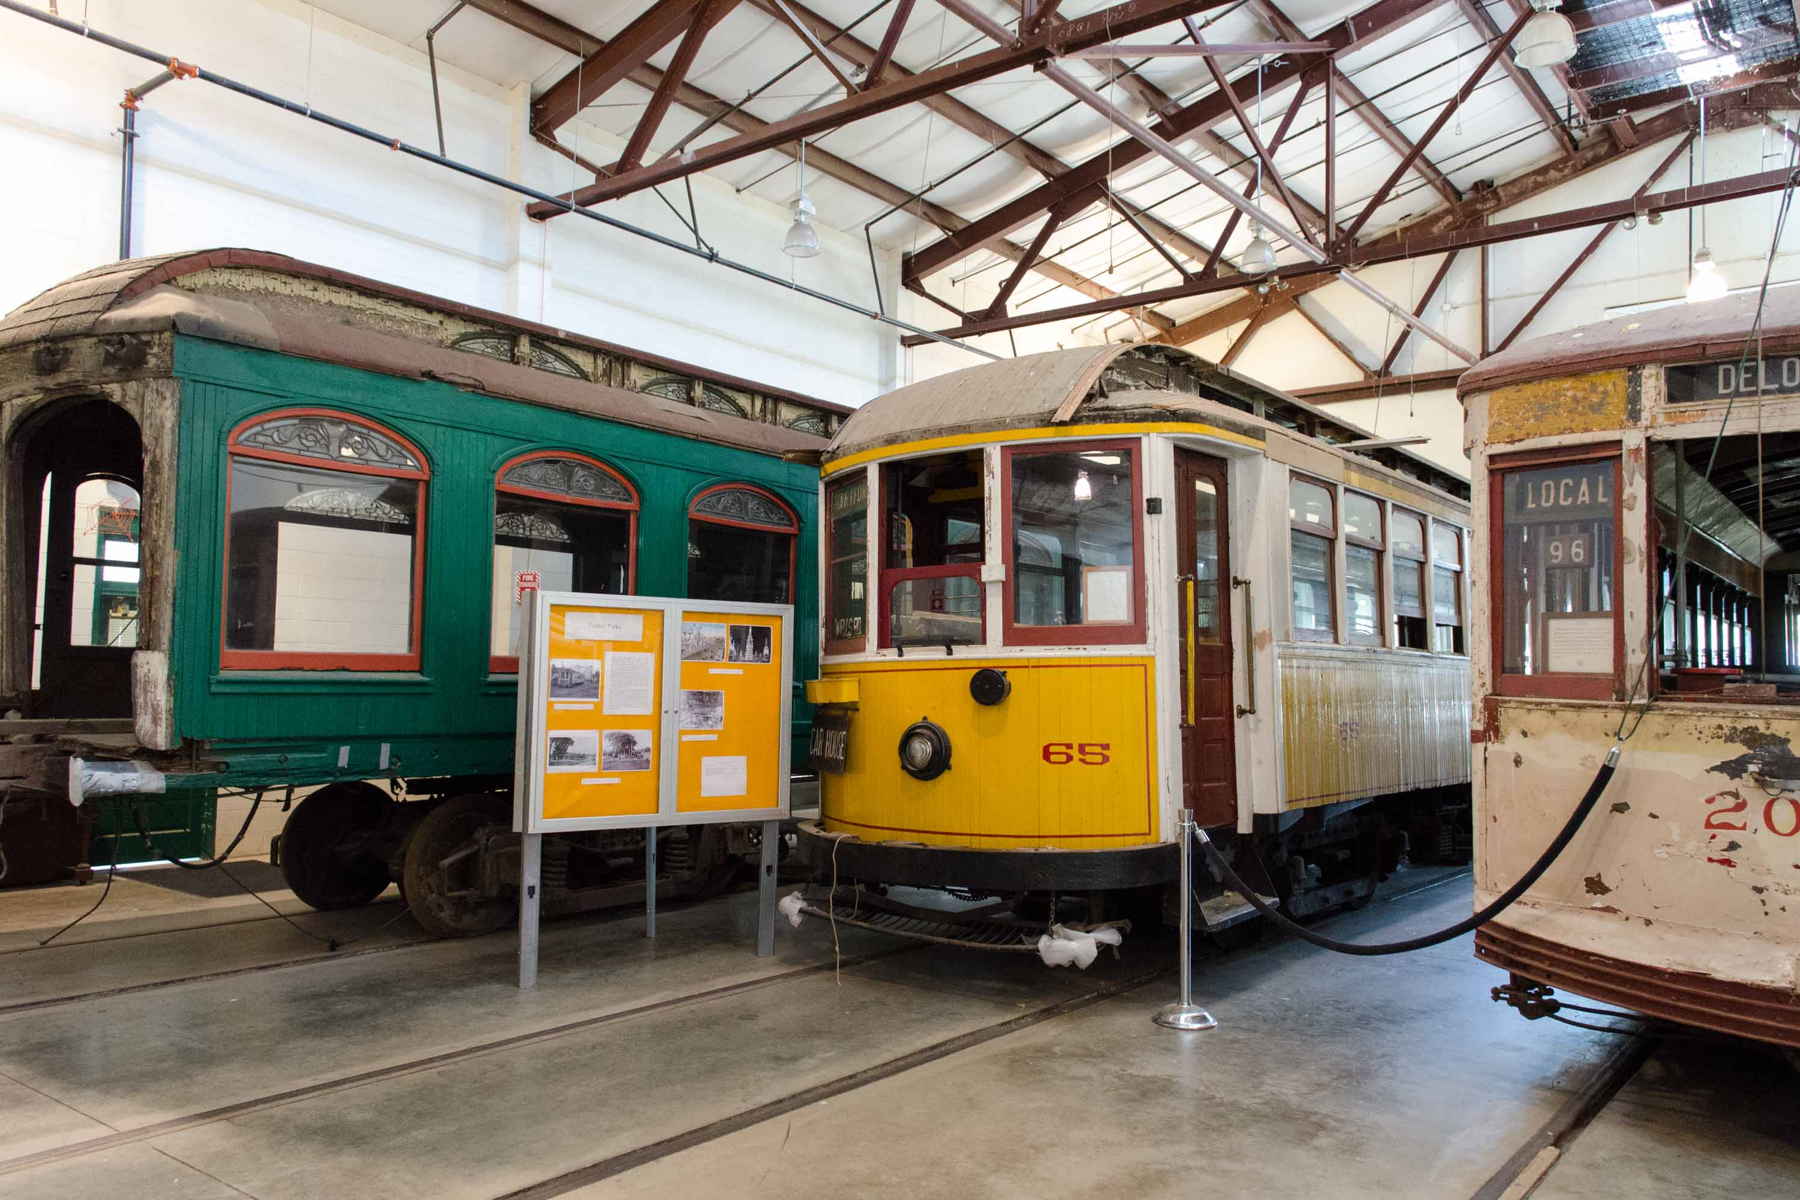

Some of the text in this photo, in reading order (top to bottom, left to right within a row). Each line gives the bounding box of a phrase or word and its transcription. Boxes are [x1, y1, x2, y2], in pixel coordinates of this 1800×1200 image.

[1718, 357, 1800, 395] DELO
[1526, 475, 1609, 509] LOCAL
[1550, 539, 1585, 564] 96
[1041, 742, 1111, 766] 65
[1704, 790, 1800, 837] 20
